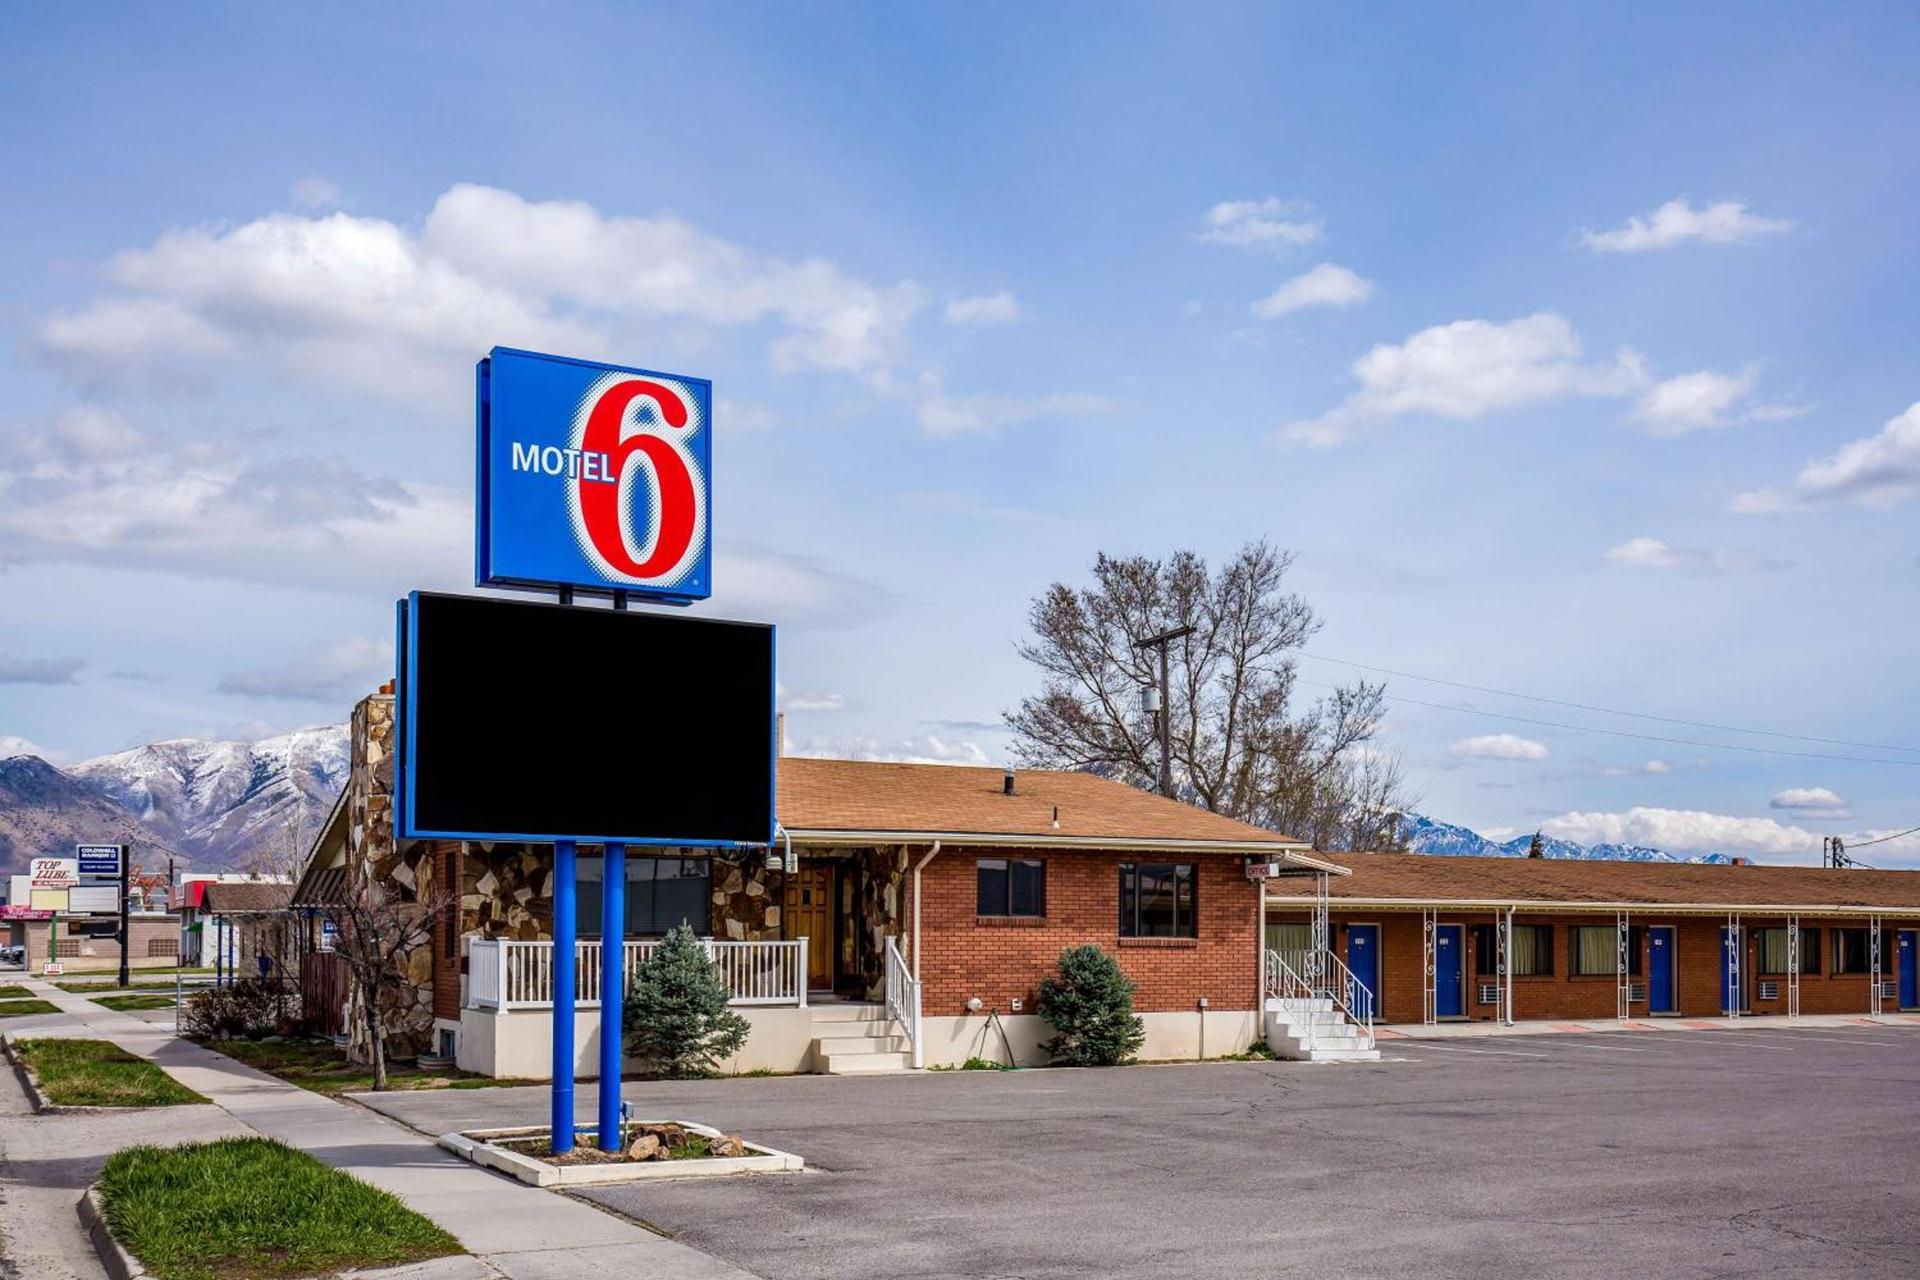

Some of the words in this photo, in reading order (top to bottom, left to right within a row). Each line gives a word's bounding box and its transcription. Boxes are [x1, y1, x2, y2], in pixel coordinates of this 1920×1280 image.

[512, 442, 615, 482] MOTEL
[579, 380, 697, 578] 6
[36, 860, 61, 870] TOP
[36, 870, 70, 879] LUBE
